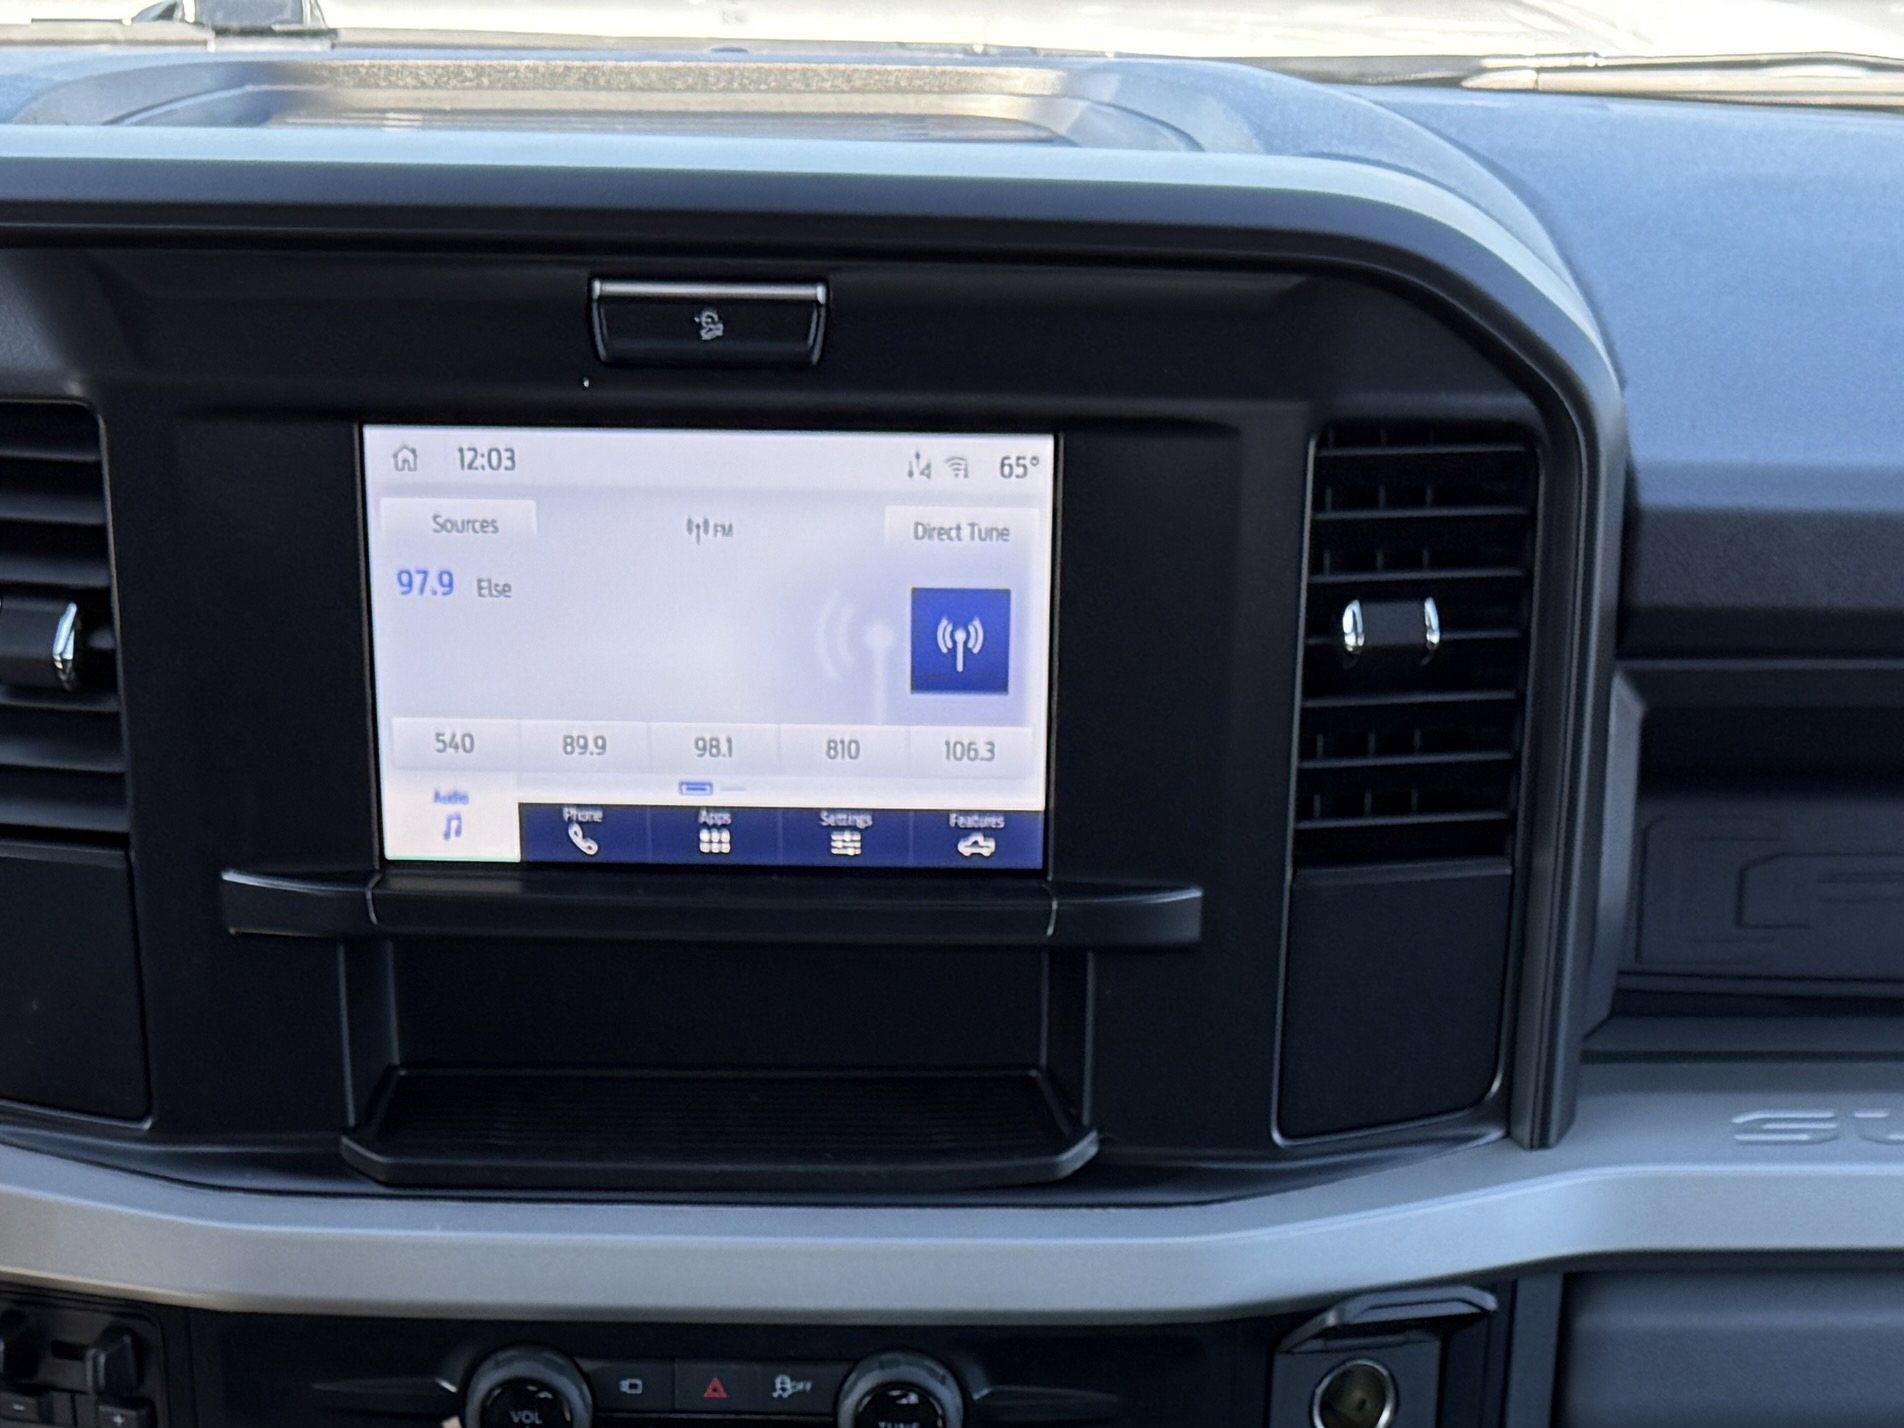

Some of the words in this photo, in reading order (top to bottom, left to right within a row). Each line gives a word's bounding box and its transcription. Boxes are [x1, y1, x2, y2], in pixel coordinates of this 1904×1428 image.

[457, 446, 516, 471] 12:03
[432, 514, 499, 534] Sources
[713, 523, 734, 537] FM
[914, 521, 963, 542] Direct
[967, 522, 1010, 542] Tune
[397, 569, 454, 596] 97.9
[476, 578, 512, 598] Else
[434, 732, 475, 754] 540
[562, 735, 607, 756] 89.9
[694, 736, 733, 758] 98.1
[825, 739, 861, 760] 810
[944, 740, 996, 762] 106.3
[563, 806, 604, 823] Phone
[698, 809, 732, 827] Apps
[820, 811, 873, 829] Settings
[949, 812, 1005, 829] Features
[510, 1409, 544, 1425] VOL
